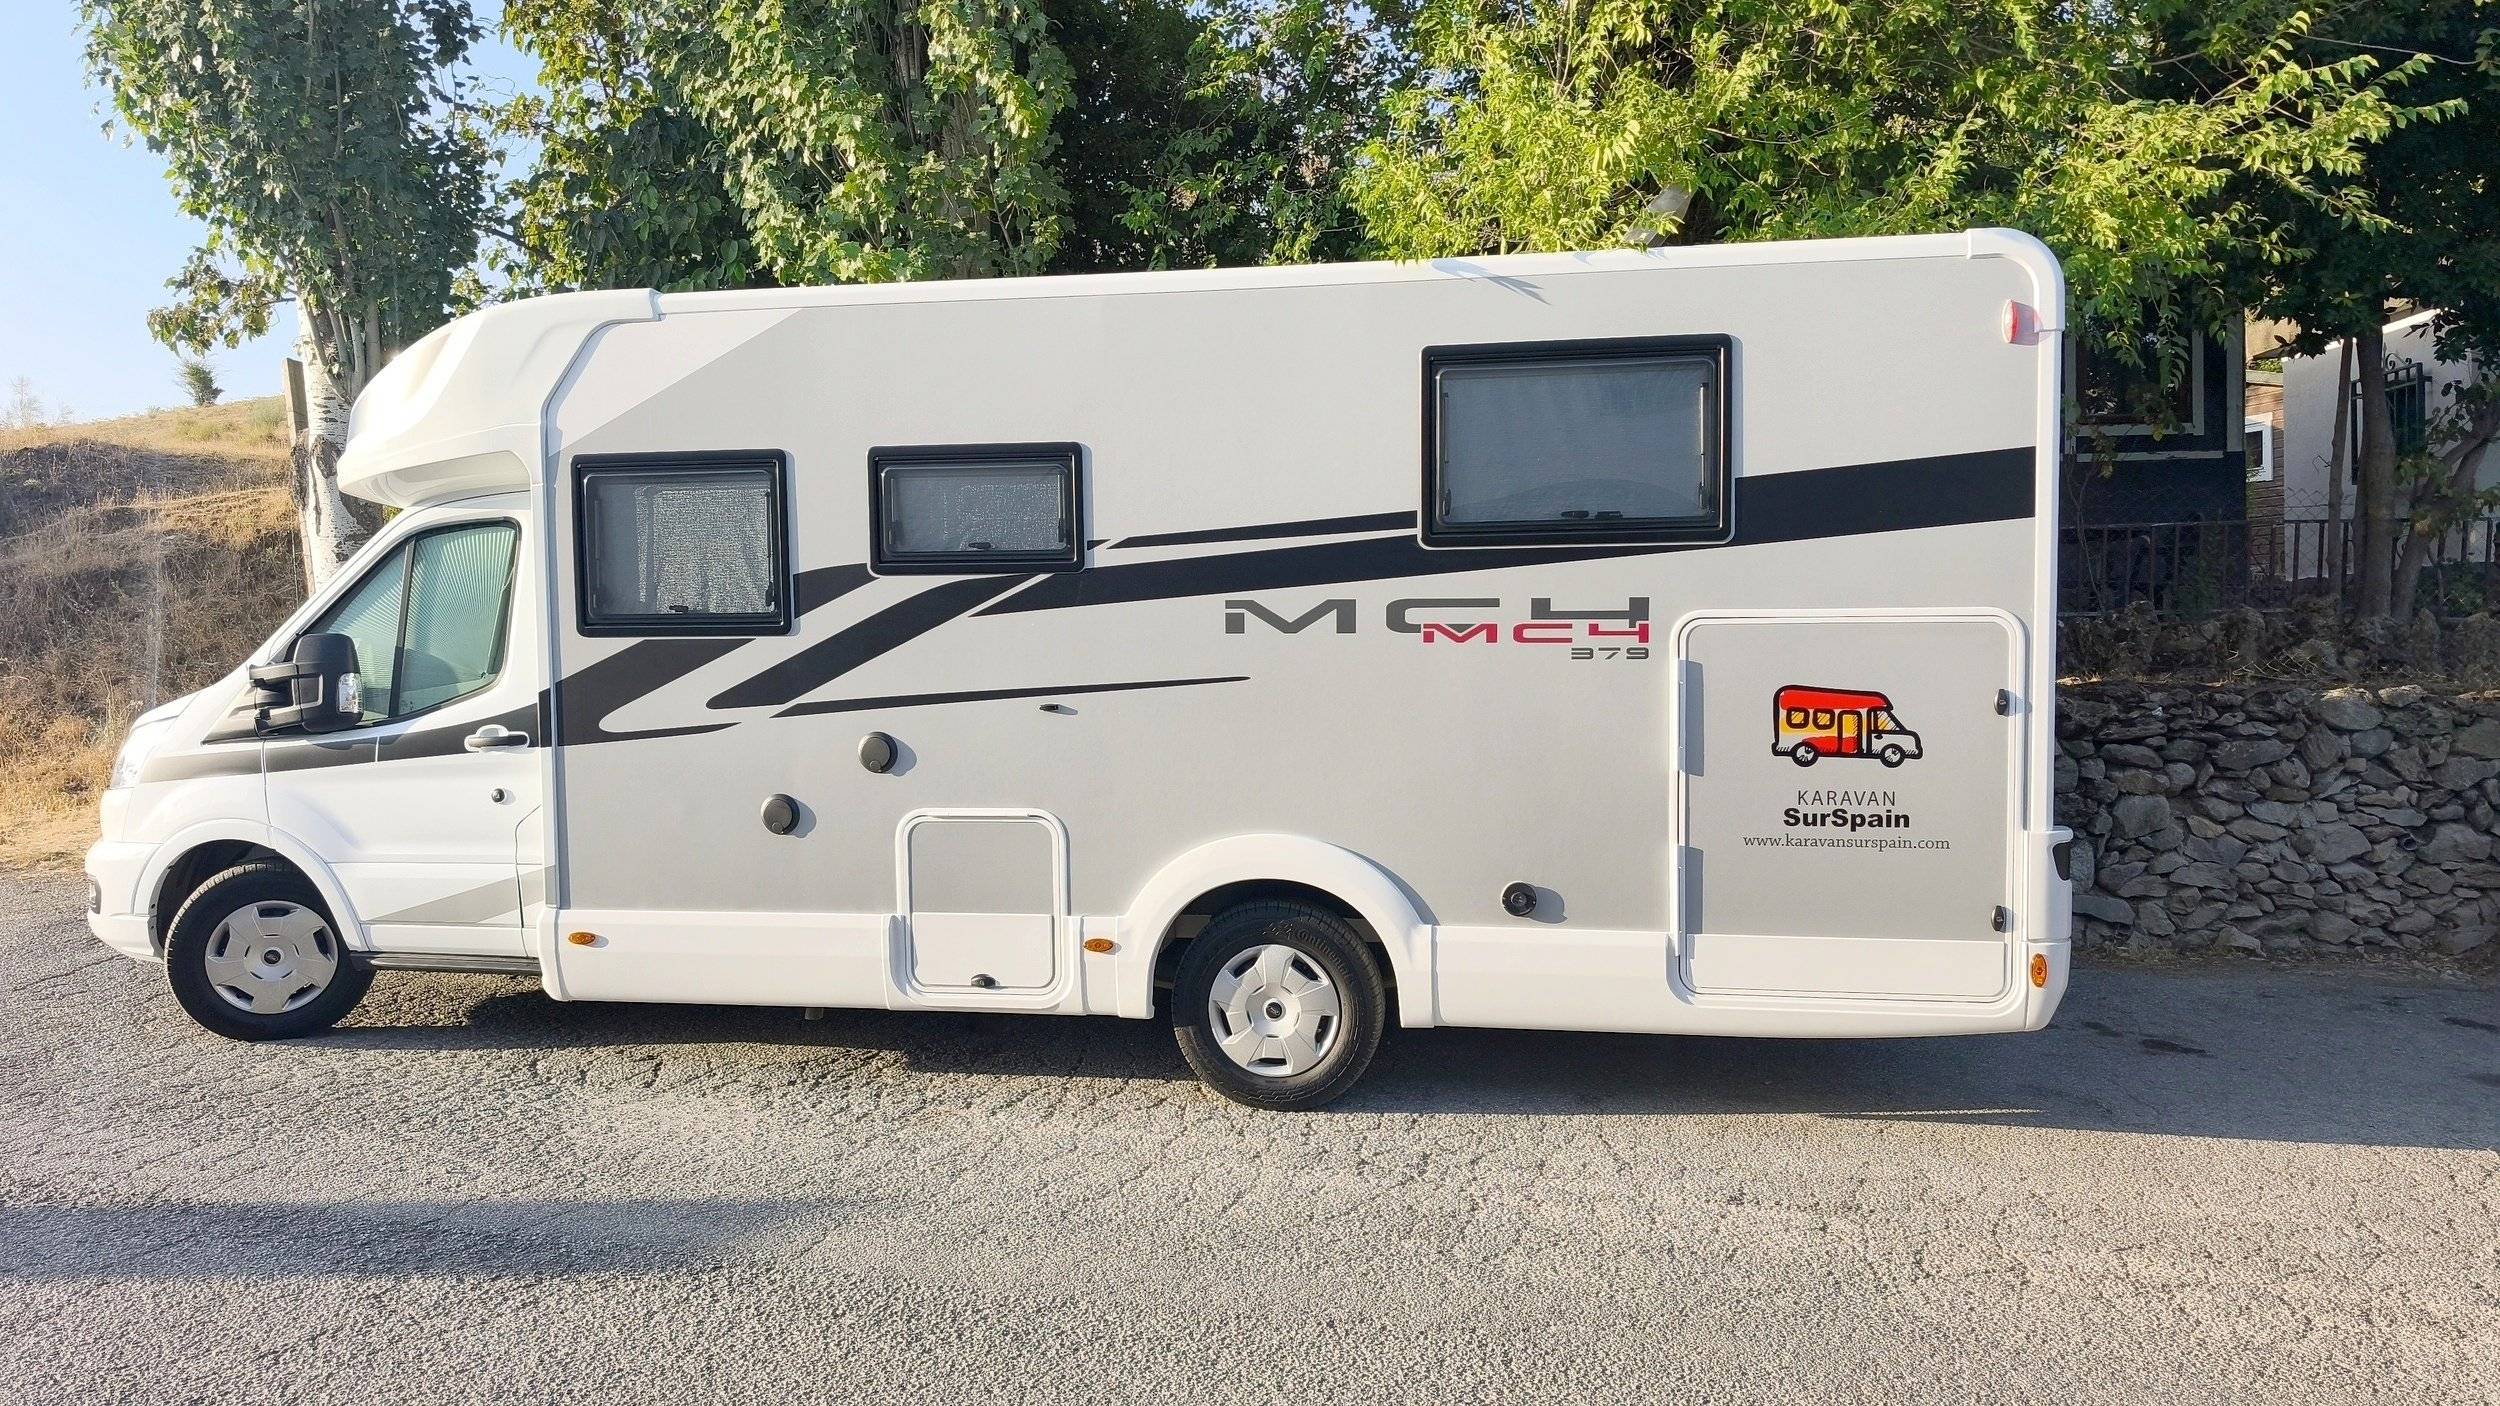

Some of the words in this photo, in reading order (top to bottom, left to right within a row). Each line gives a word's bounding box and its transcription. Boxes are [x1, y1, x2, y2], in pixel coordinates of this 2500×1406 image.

[1225, 597, 1650, 634] MC4
[1422, 622, 1650, 644] MC4
[1570, 647, 1650, 660] 379
[1797, 790, 1896, 806] KARAVAN
[1783, 807, 1910, 832] SurSpain
[1743, 833, 1951, 852] www.karavansurspain.com
